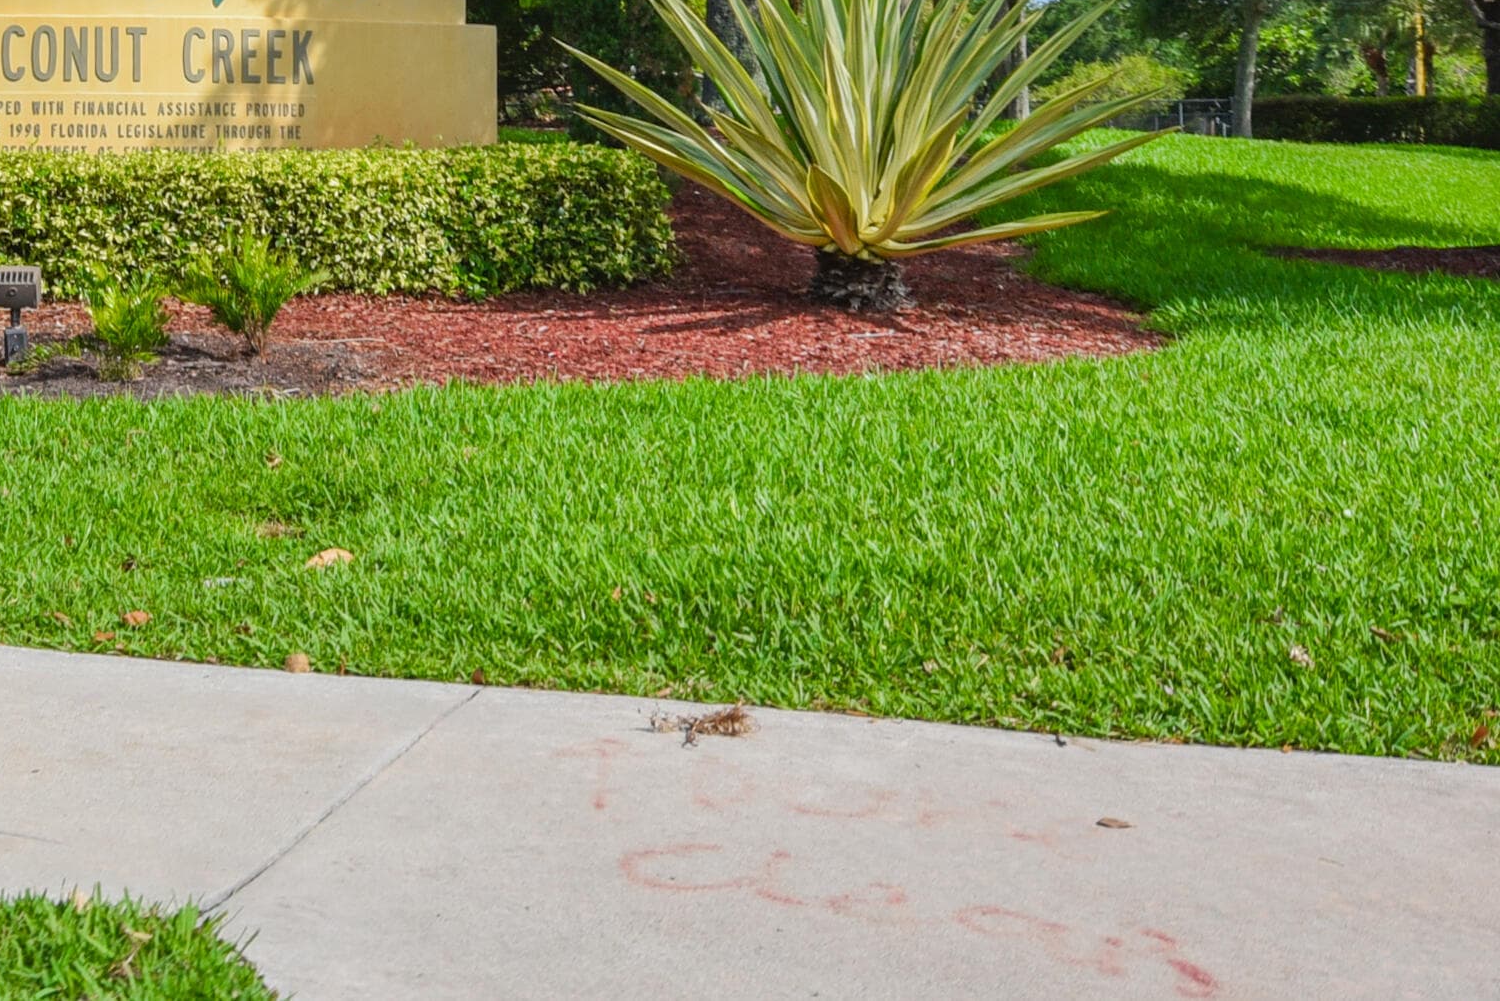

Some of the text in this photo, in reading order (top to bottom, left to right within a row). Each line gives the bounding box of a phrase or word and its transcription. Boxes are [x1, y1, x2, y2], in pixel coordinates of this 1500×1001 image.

[182, 26, 316, 85] CREEK
[31, 100, 65, 117] WITH
[73, 100, 147, 117] FINANCIAL
[157, 101, 237, 117] ASSISTANCE
[245, 102, 306, 118] PROVIDED
[9, 123, 41, 139] 1998
[50, 123, 108, 139] FLORIDA
[117, 124, 206, 140] LEGISLATURE
[215, 124, 272, 140] THROUGH
[279, 125, 302, 140] THE
